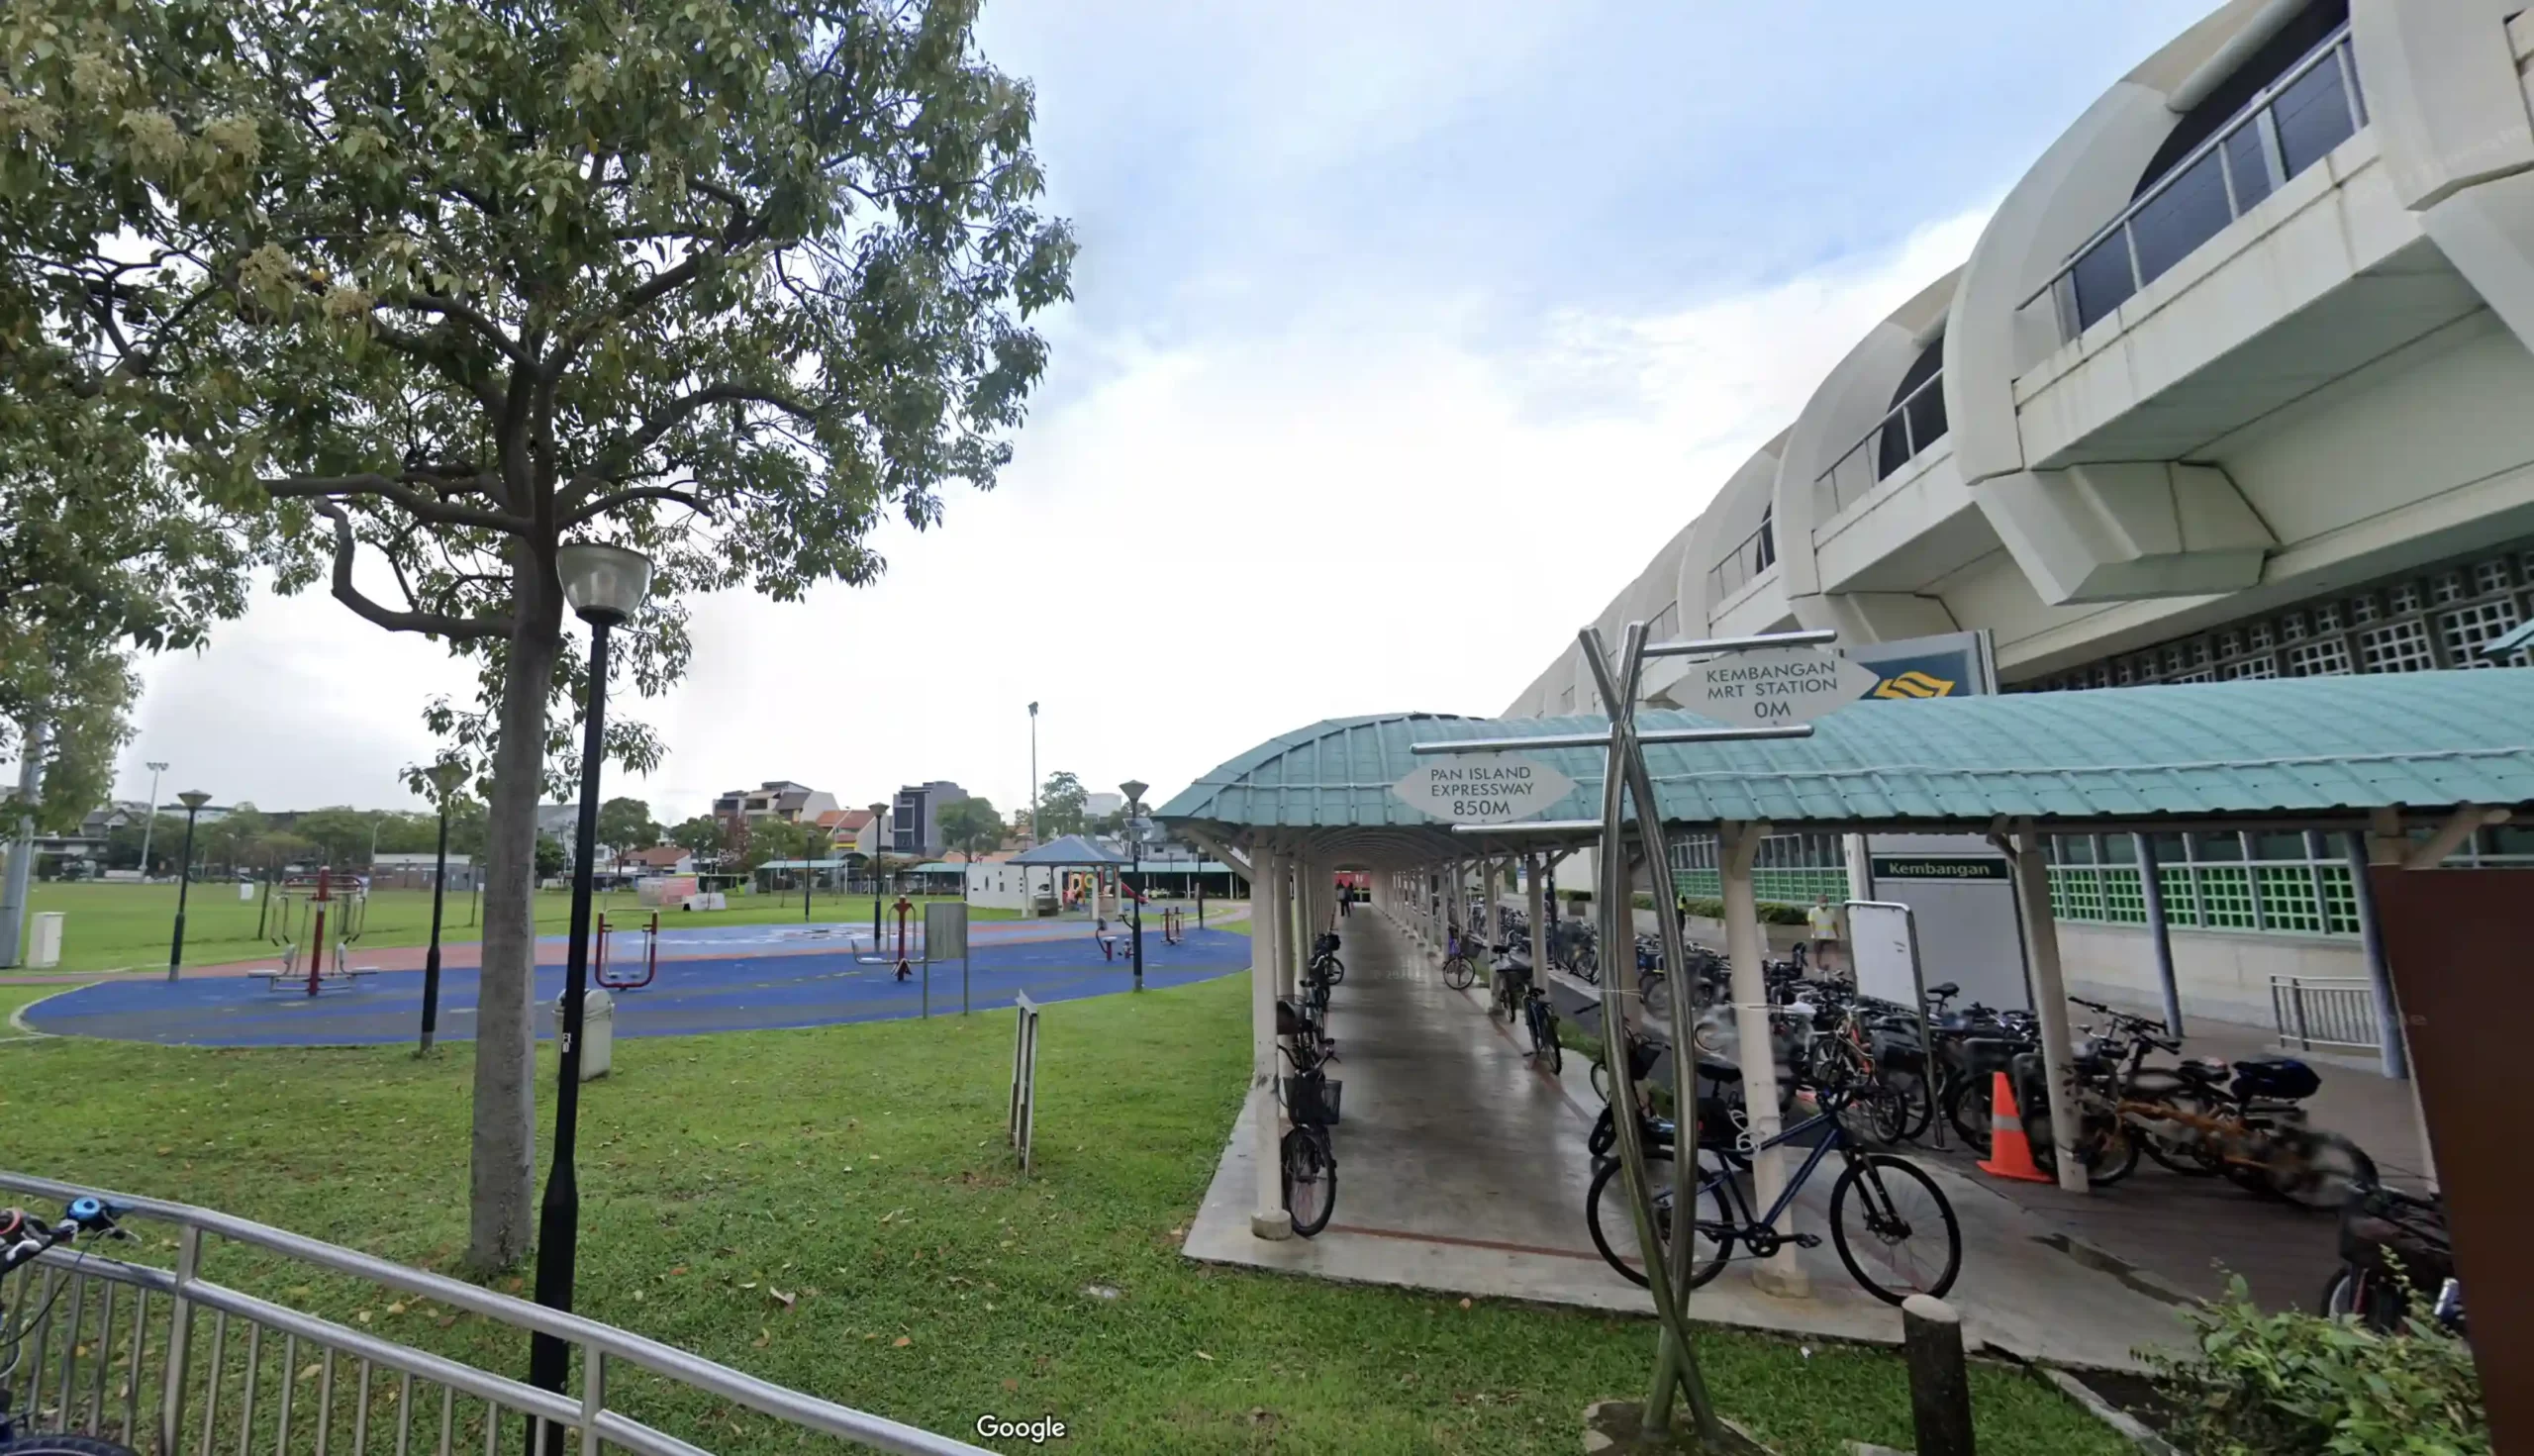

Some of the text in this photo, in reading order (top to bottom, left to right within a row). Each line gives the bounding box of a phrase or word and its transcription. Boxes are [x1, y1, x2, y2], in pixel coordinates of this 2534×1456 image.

[1706, 660, 1836, 683] KEMBANGAN
[1707, 678, 1838, 701] MRT STATION
[1754, 701, 1792, 719] 0M
[1431, 766, 1531, 781] PAN ISLAND
[1431, 782, 1534, 797] EXPRESSWAY
[1453, 800, 1511, 816] 850M
[1889, 862, 1991, 878] Kembangan
